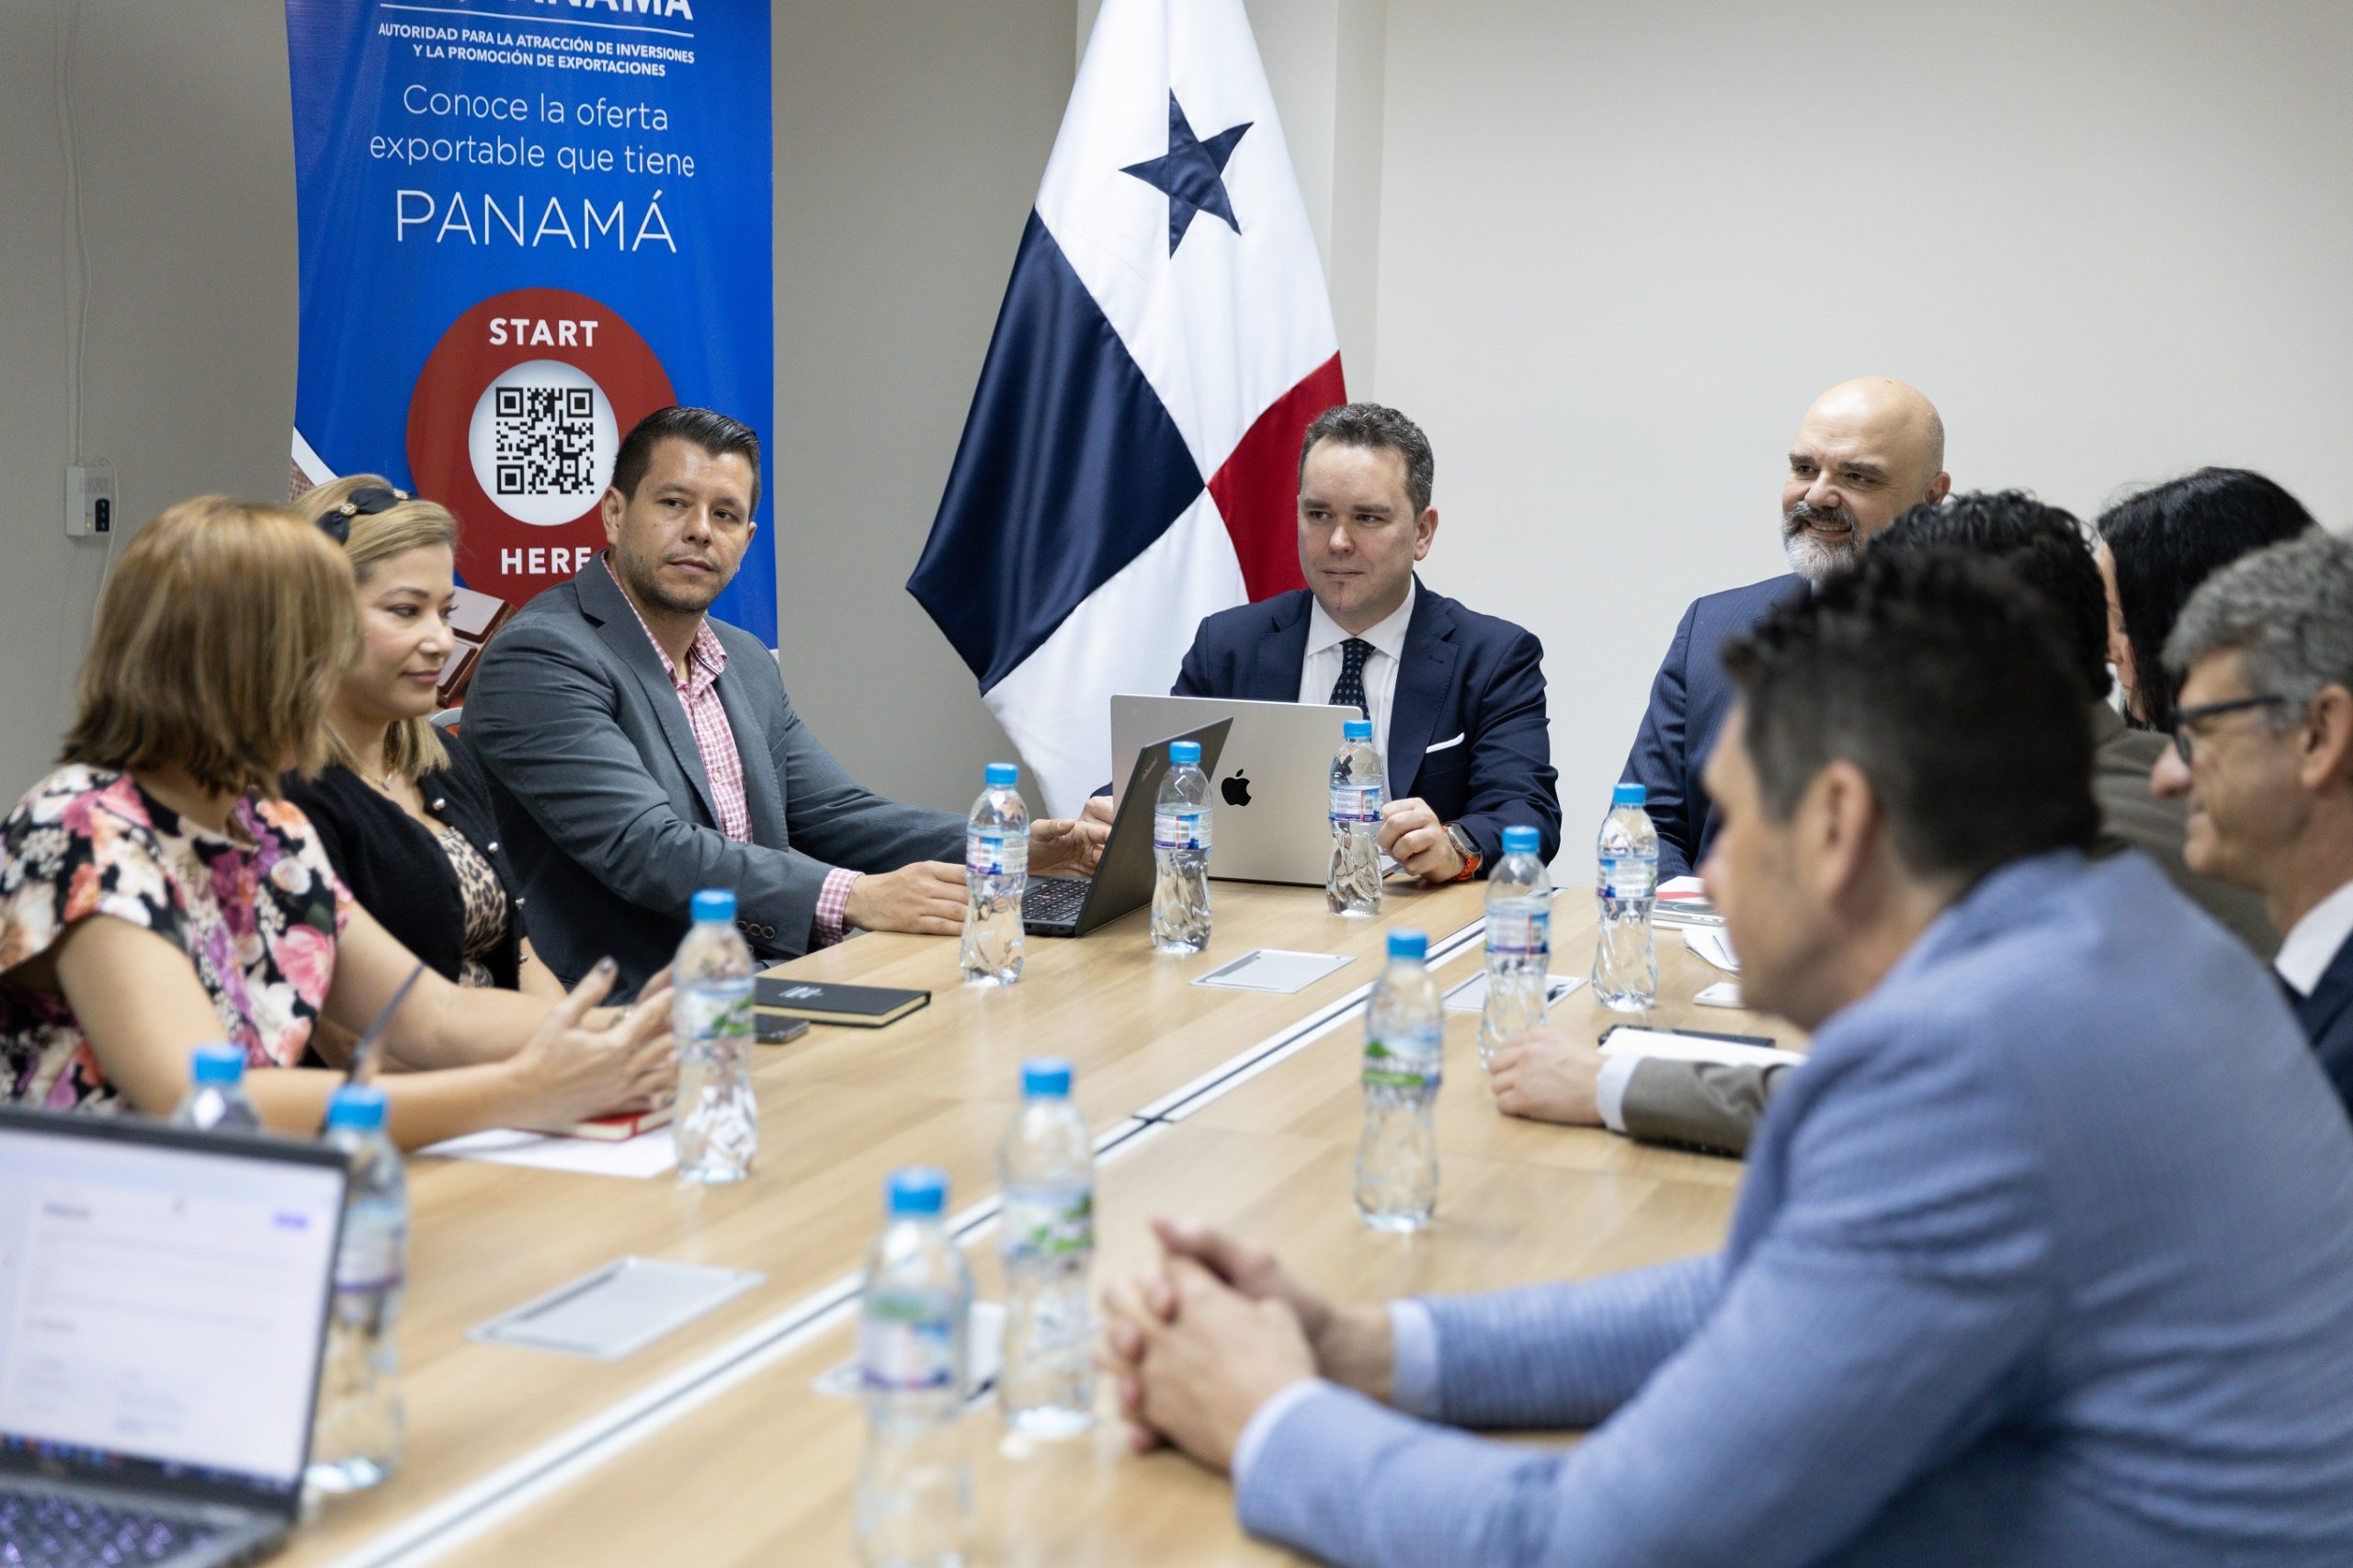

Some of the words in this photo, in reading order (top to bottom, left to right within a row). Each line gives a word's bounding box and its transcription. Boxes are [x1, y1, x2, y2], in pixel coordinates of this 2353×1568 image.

[378, 22, 459, 40] AUTORIDAD
[461, 28, 494, 44] PARA
[496, 32, 514, 46] LA
[516, 34, 594, 53] ATRACCIÓN
[596, 41, 614, 55] DE
[616, 42, 695, 64] INVERSIONES
[413, 44, 423, 57] Y
[426, 45, 445, 58] LA
[448, 46, 534, 66] PROMOCIÓN
[536, 53, 555, 67] DE
[558, 55, 666, 77] EXPORTACIONES
[404, 85, 528, 121] Conoce
[540, 93, 564, 123] la
[576, 97, 668, 131] oferta
[369, 135, 545, 167] exportable
[557, 146, 614, 175] que
[624, 145, 695, 177] tiene
[396, 189, 677, 254] PANAMÁ
[489, 317, 598, 347] START
